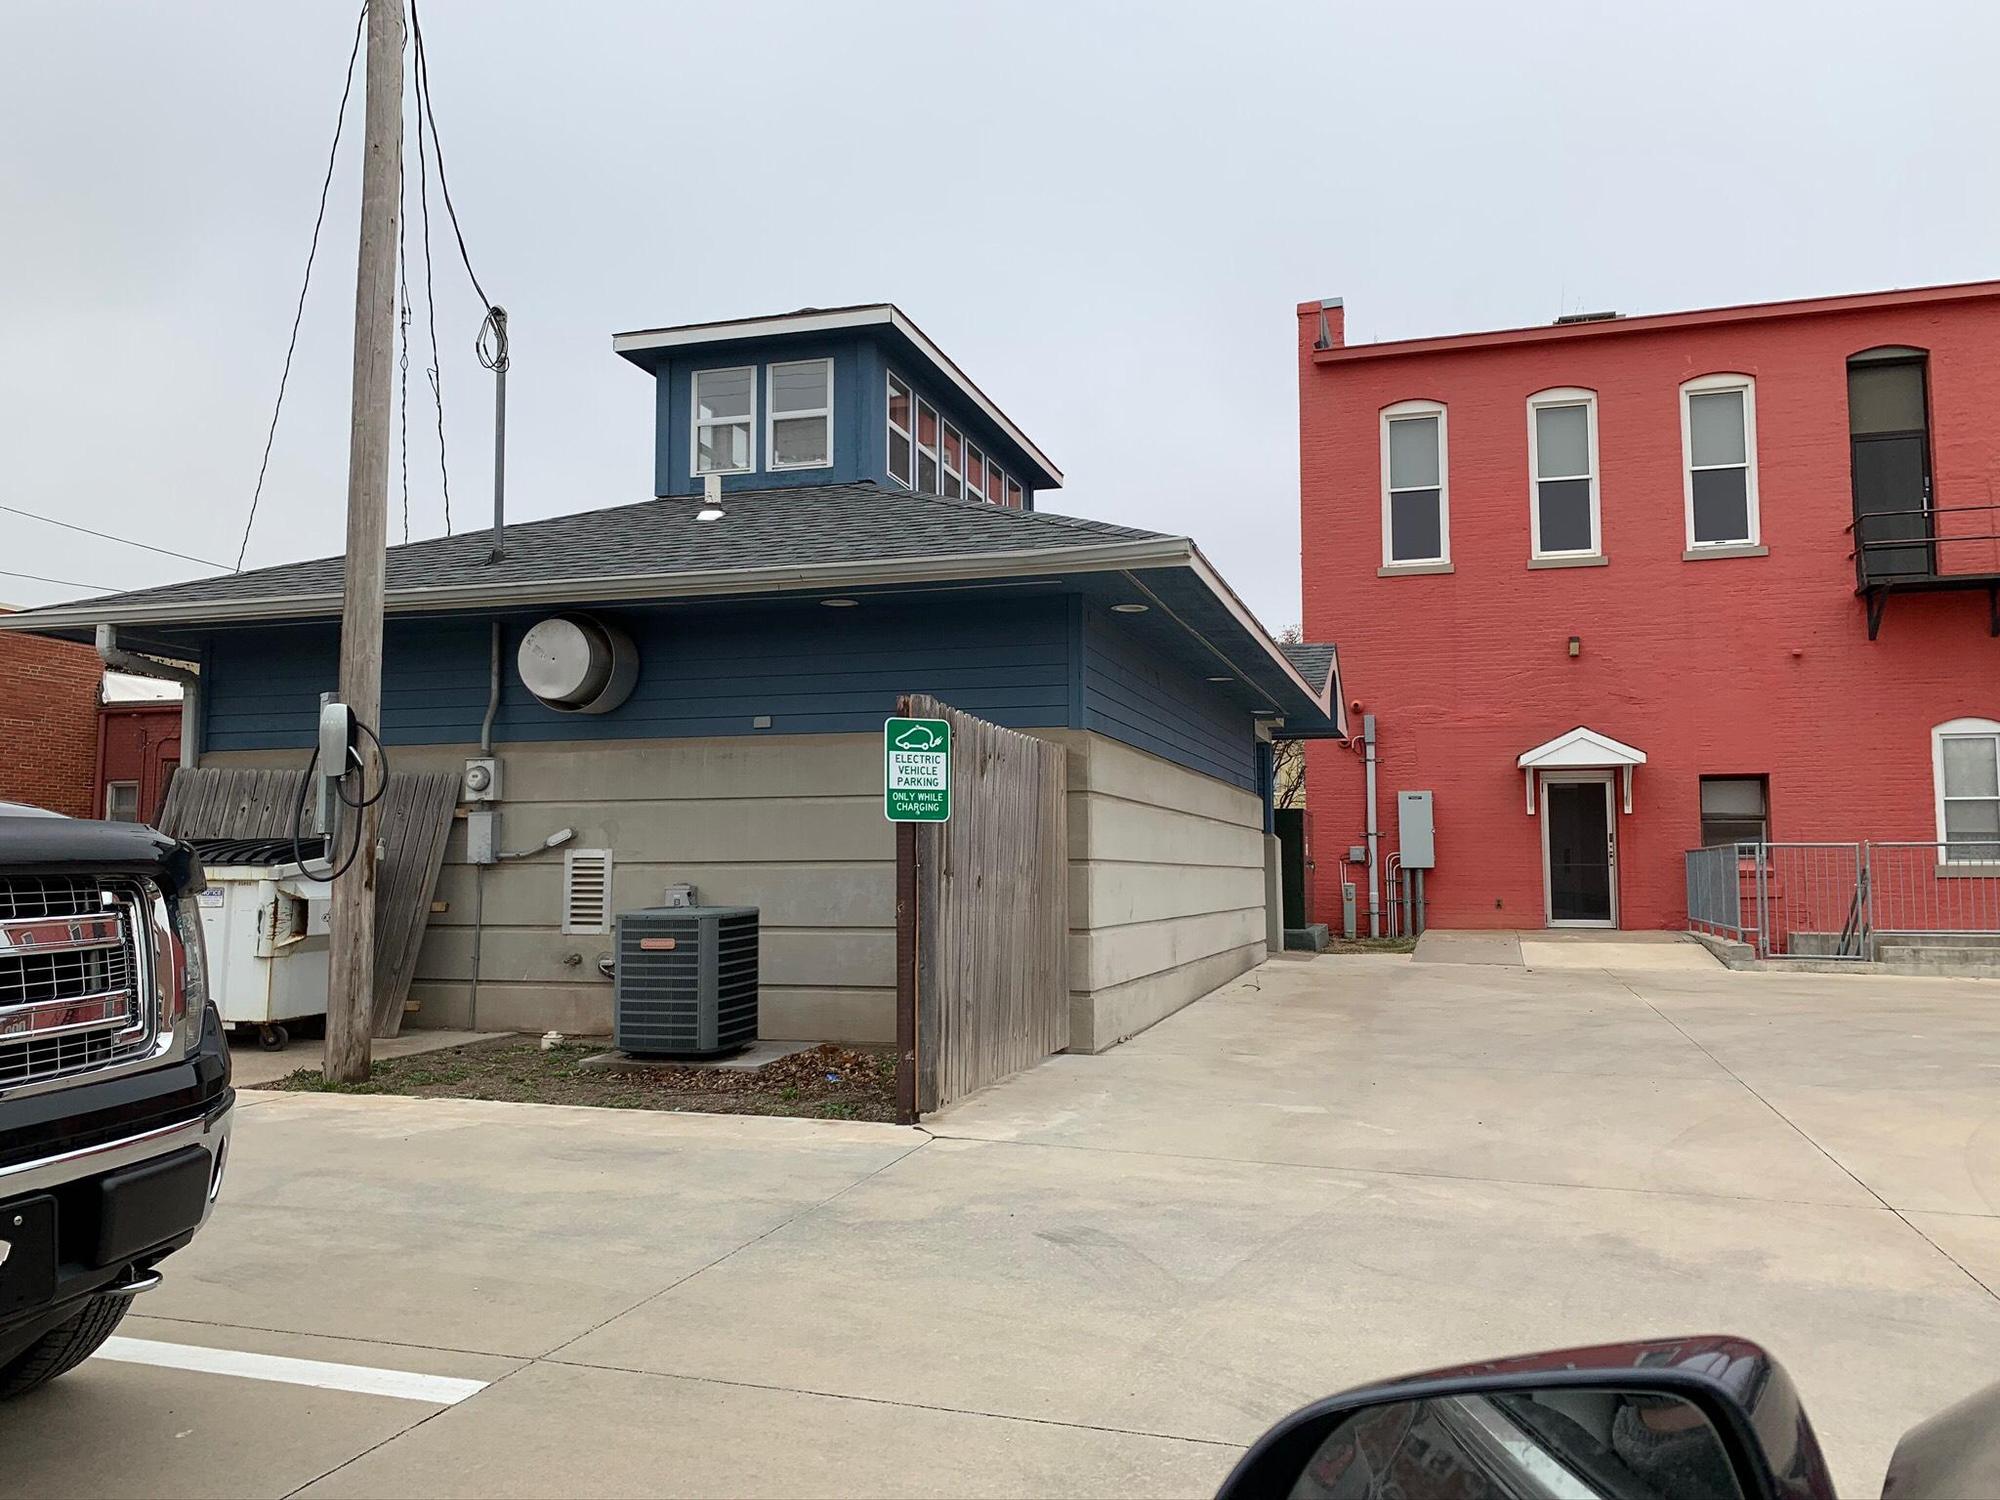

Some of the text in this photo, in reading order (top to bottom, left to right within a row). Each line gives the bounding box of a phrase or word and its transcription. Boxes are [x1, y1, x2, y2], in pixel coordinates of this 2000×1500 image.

[895, 754, 941, 764] ELECTRIC
[898, 766, 938, 775] VEHICLE
[897, 777, 939, 787] PARKING
[892, 792, 943, 801] ONLY WHILE
[896, 802, 939, 811] CHARGING
